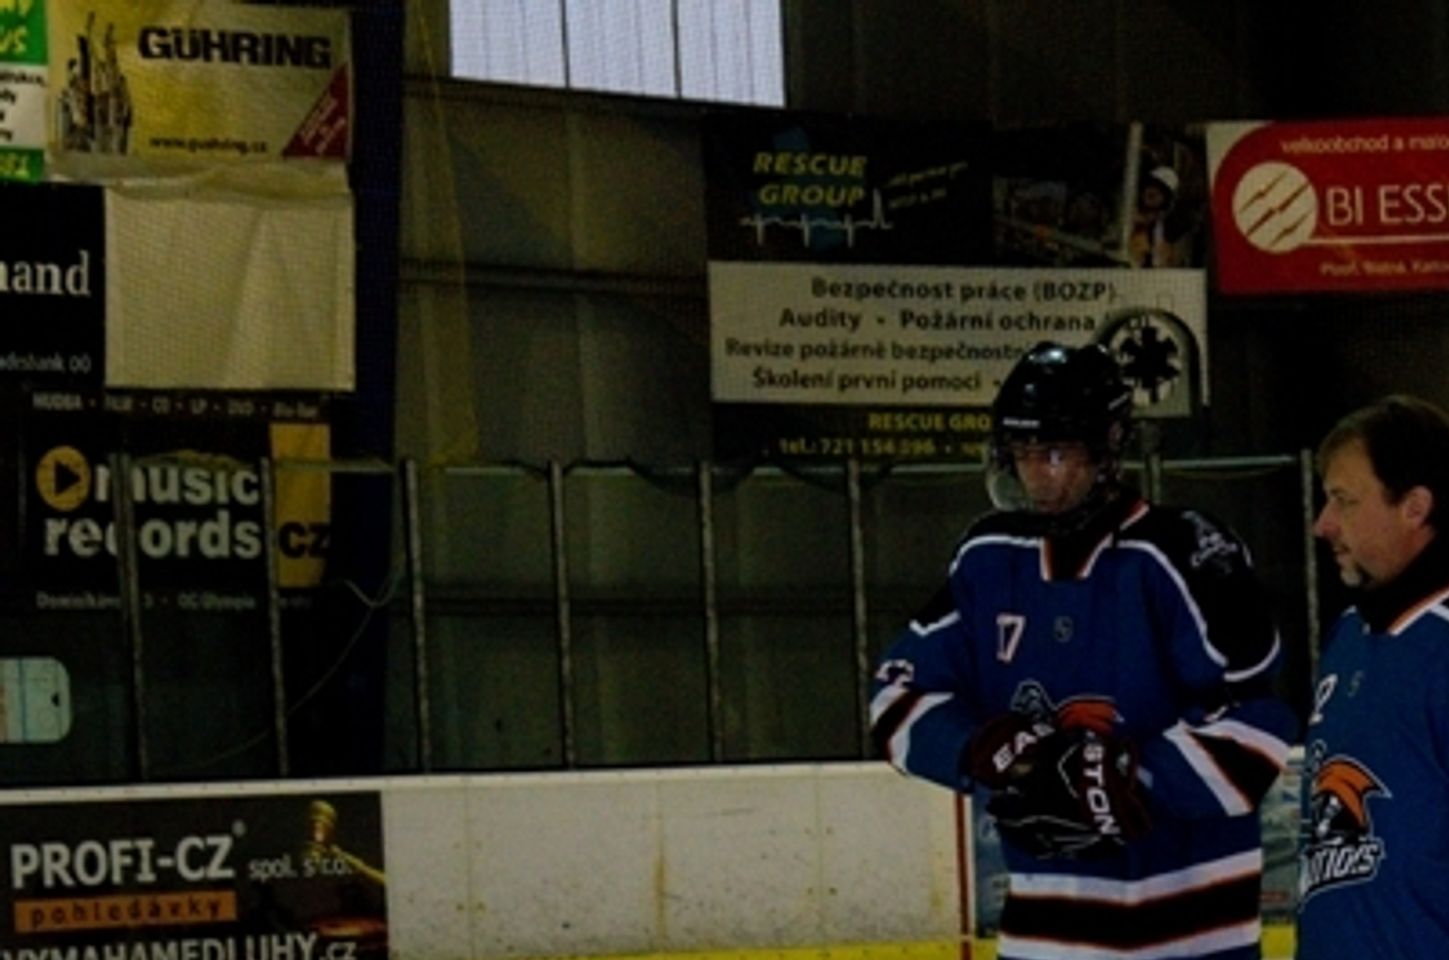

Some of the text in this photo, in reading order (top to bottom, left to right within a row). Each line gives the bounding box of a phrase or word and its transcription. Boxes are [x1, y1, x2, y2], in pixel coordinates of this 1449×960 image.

[753, 152, 869, 177] RESCUE
[760, 184, 867, 208] GROUP
[1326, 186, 1364, 226] BI
[812, 276, 953, 300] Bezpečnost
[961, 279, 1026, 300] práce
[780, 308, 1095, 332] Audity Požární ochrana
[725, 338, 794, 357] Revize
[753, 366, 981, 393] Školení první pomoci
[868, 411, 944, 431] RESCUE
[948, 411, 993, 431] GRO
[94, 463, 260, 507] music
[9, 834, 235, 889] PROFI-CZ
